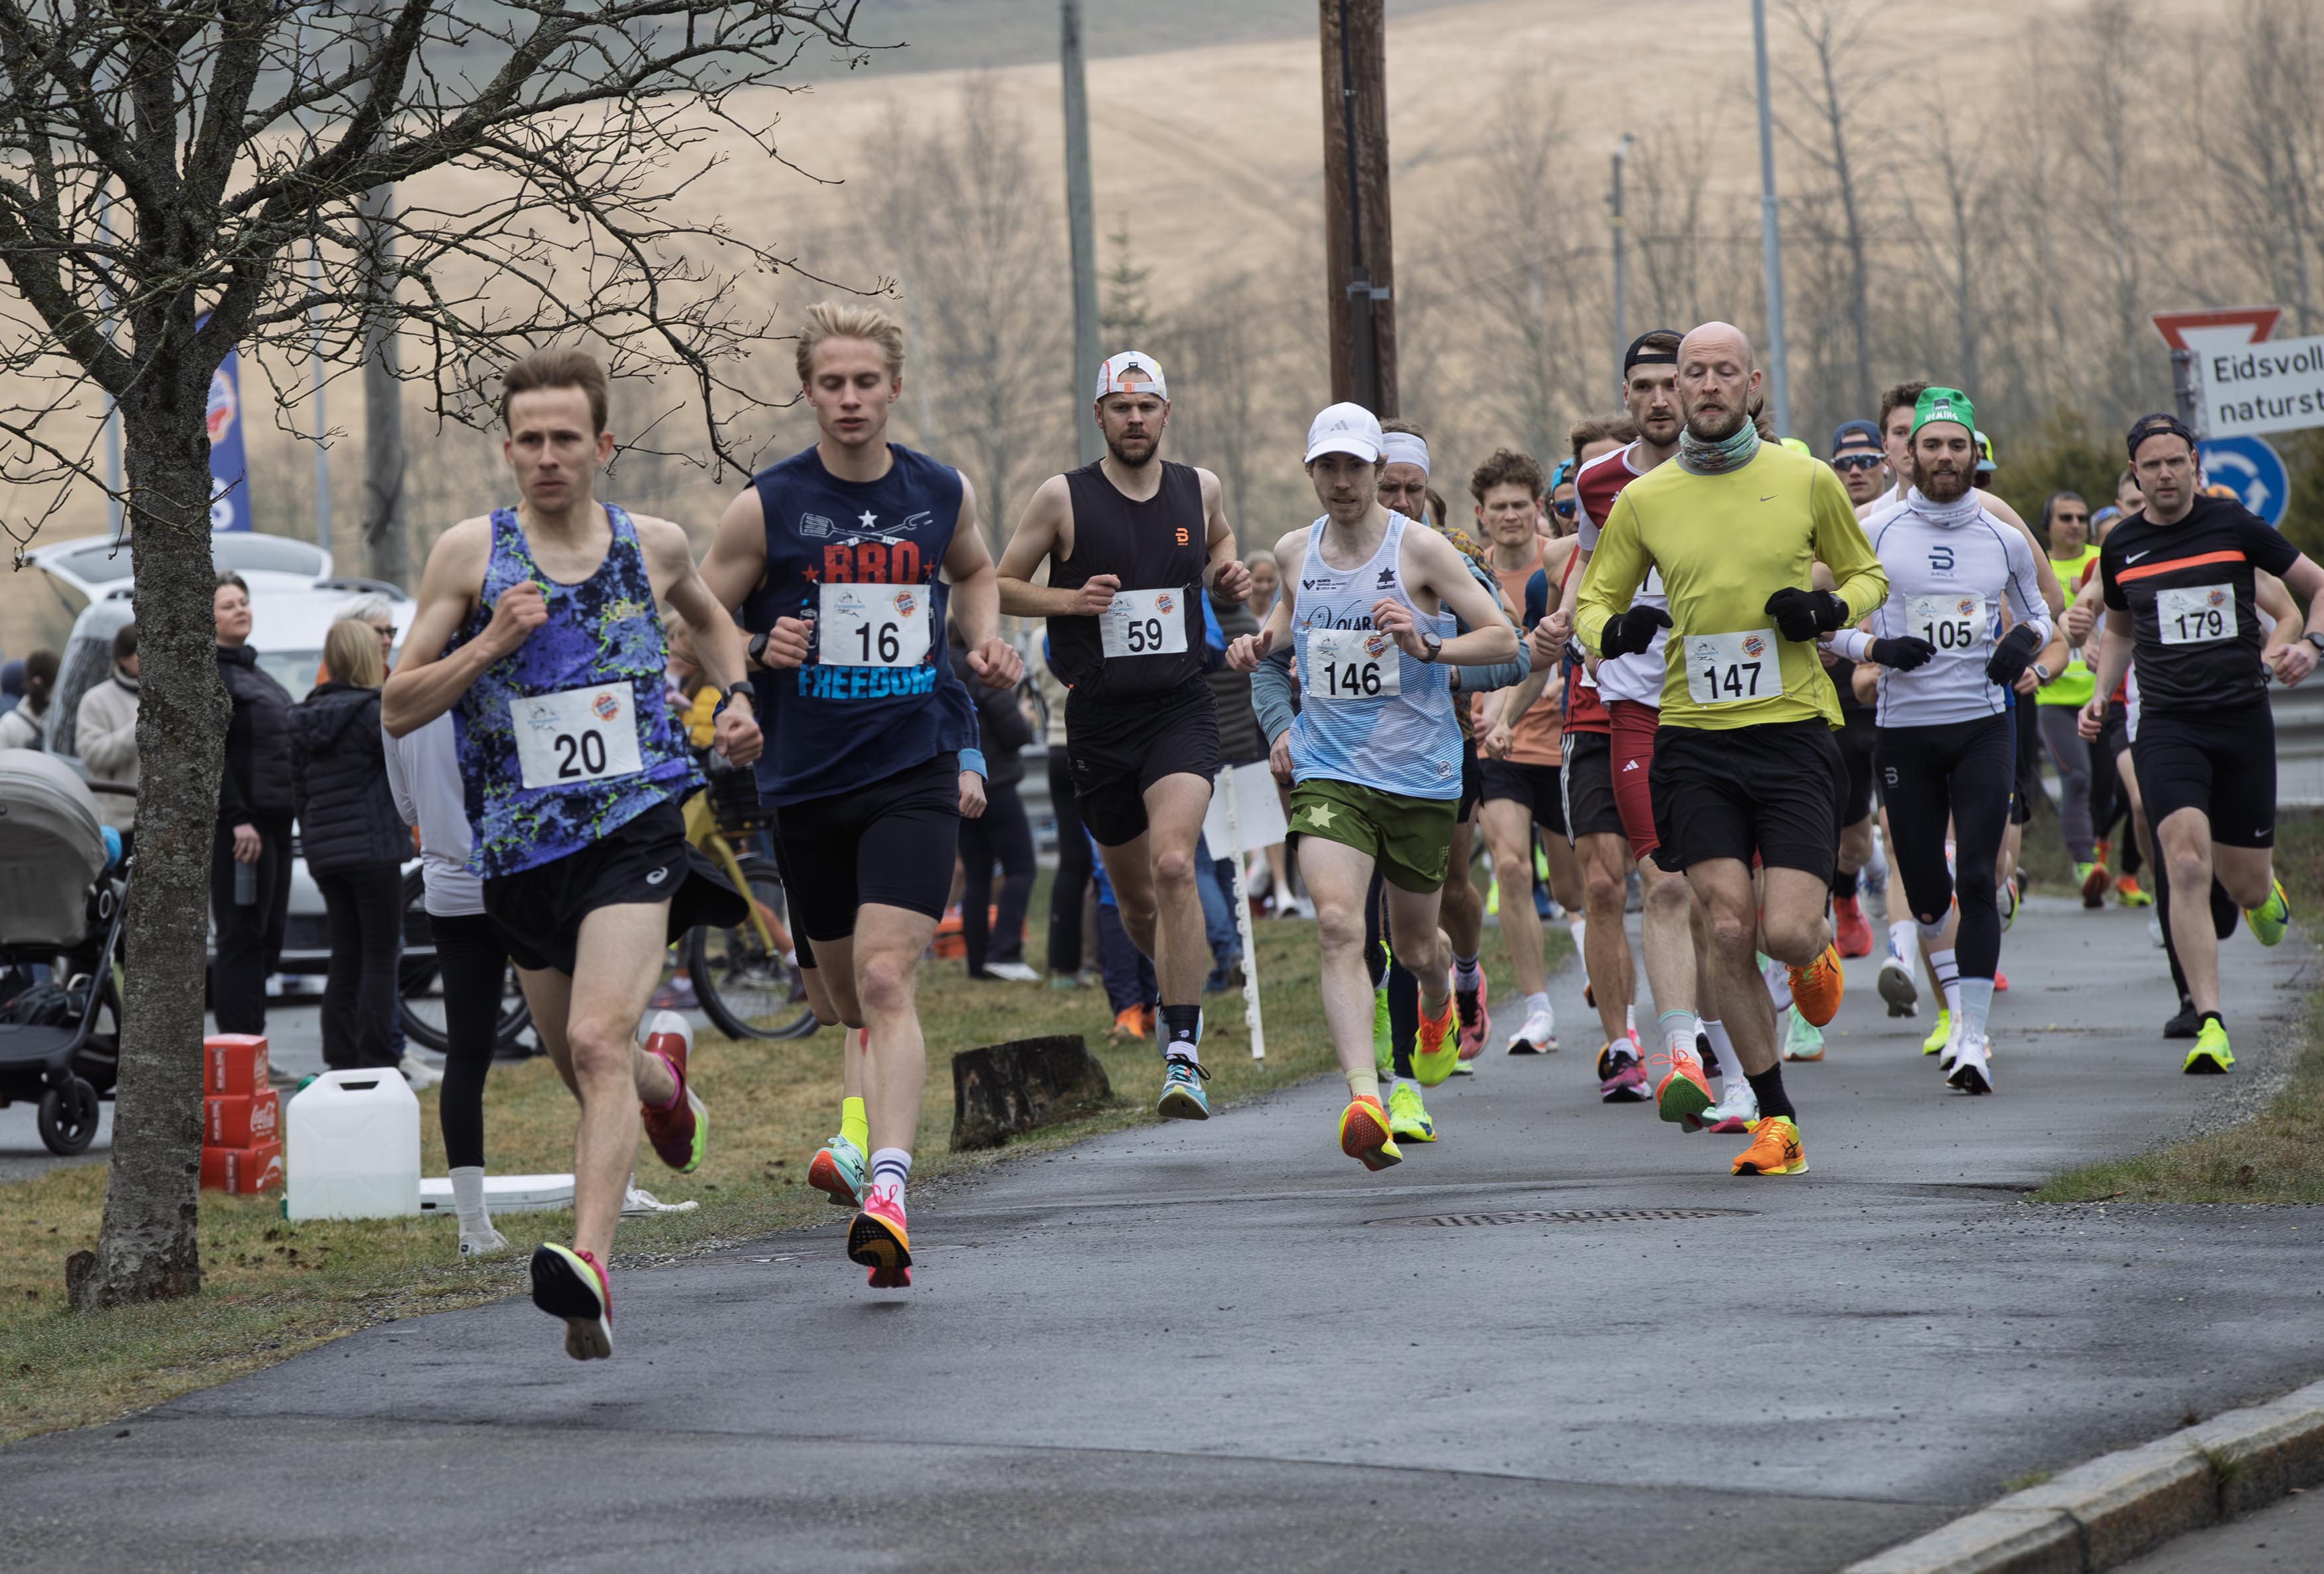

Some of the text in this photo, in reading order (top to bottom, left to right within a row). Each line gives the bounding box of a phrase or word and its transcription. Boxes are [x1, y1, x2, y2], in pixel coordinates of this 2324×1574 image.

[2213, 344, 2323, 383] Eidsvoll
[2220, 388, 2324, 423] naturst
[1128, 618, 1163, 652] 59
[1923, 620, 1972, 649] 105
[2175, 610, 2222, 639] 179
[855, 622, 899, 663] 16
[798, 664, 938, 699] FREEDOM
[1324, 661, 1382, 695] 146
[1703, 661, 1762, 699] 147
[554, 729, 606, 779] 20
